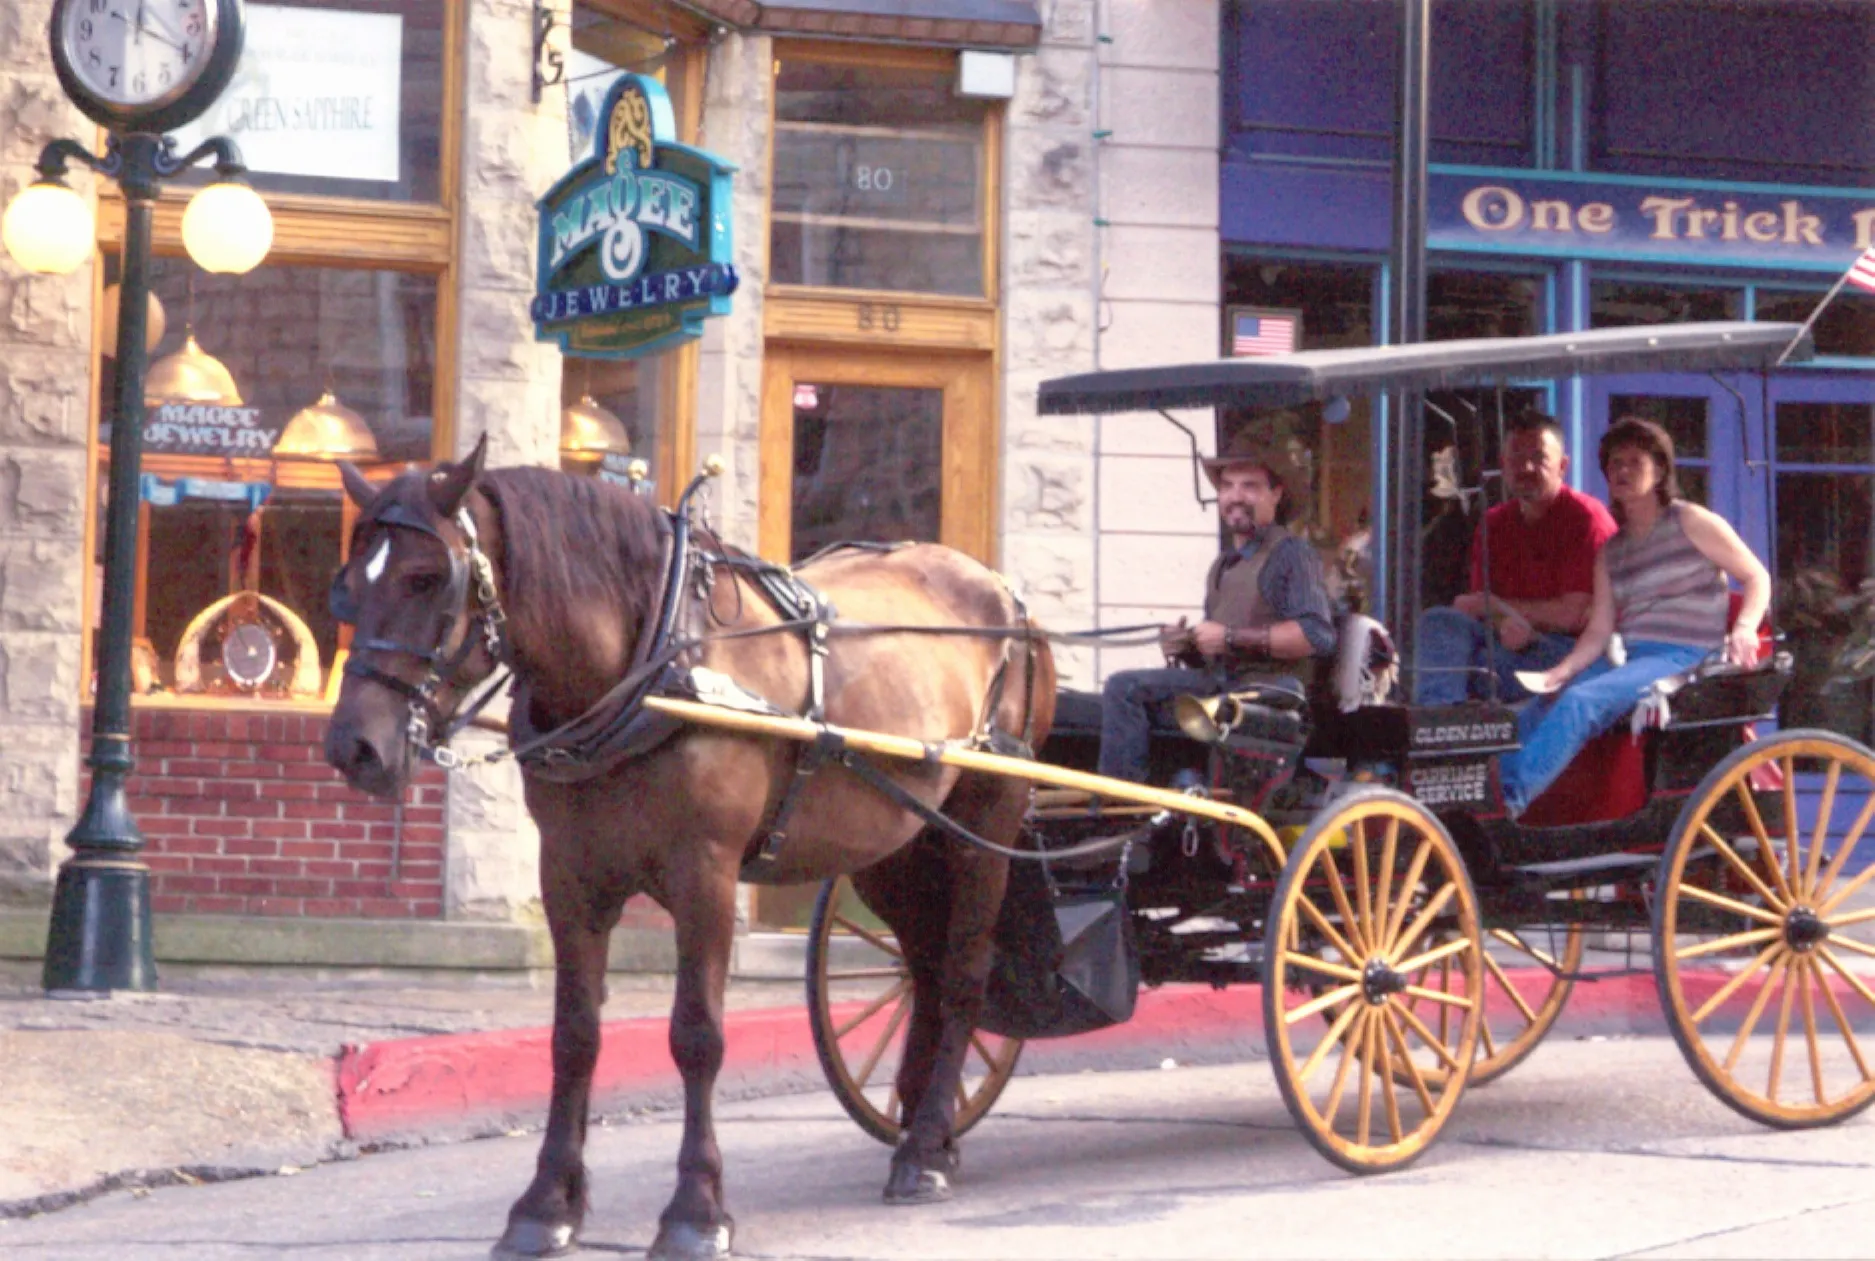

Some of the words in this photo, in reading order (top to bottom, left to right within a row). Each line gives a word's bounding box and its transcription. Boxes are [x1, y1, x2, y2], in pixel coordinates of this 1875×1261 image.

[80, 19, 93, 42] 9
[108, 66, 119, 87] 7
[132, 71, 145, 94] 6
[292, 96, 374, 131] SAPPHIRE
[857, 167, 893, 190] 80
[1462, 185, 1615, 234] One
[1639, 196, 1823, 245] Trick
[545, 269, 709, 319] JEWELRY
[143, 422, 277, 449] JEWELRY
[1415, 781, 1485, 803] SERVICE
